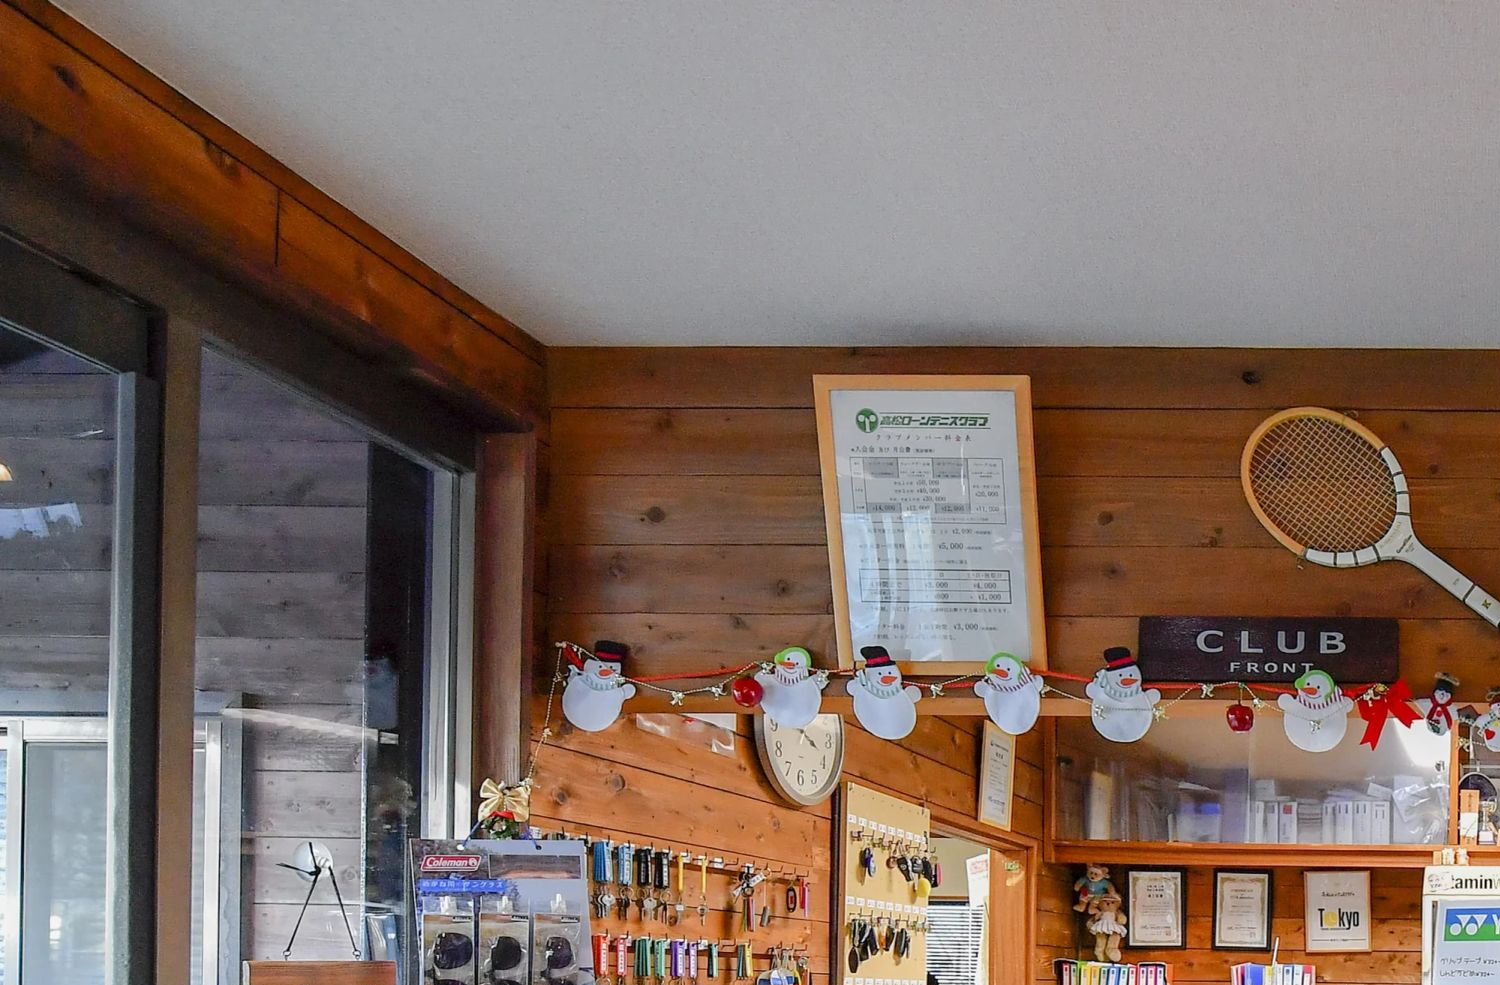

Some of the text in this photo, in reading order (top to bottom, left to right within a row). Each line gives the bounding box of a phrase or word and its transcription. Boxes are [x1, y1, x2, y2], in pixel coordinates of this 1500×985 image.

[1196, 630, 1347, 654] CLUB
[1229, 661, 1315, 673] FRONT
[775, 740, 783, 758] 8
[825, 733, 832, 749] 3
[785, 760, 818, 786] 7 6 5
[426, 858, 468, 867] Coleman
